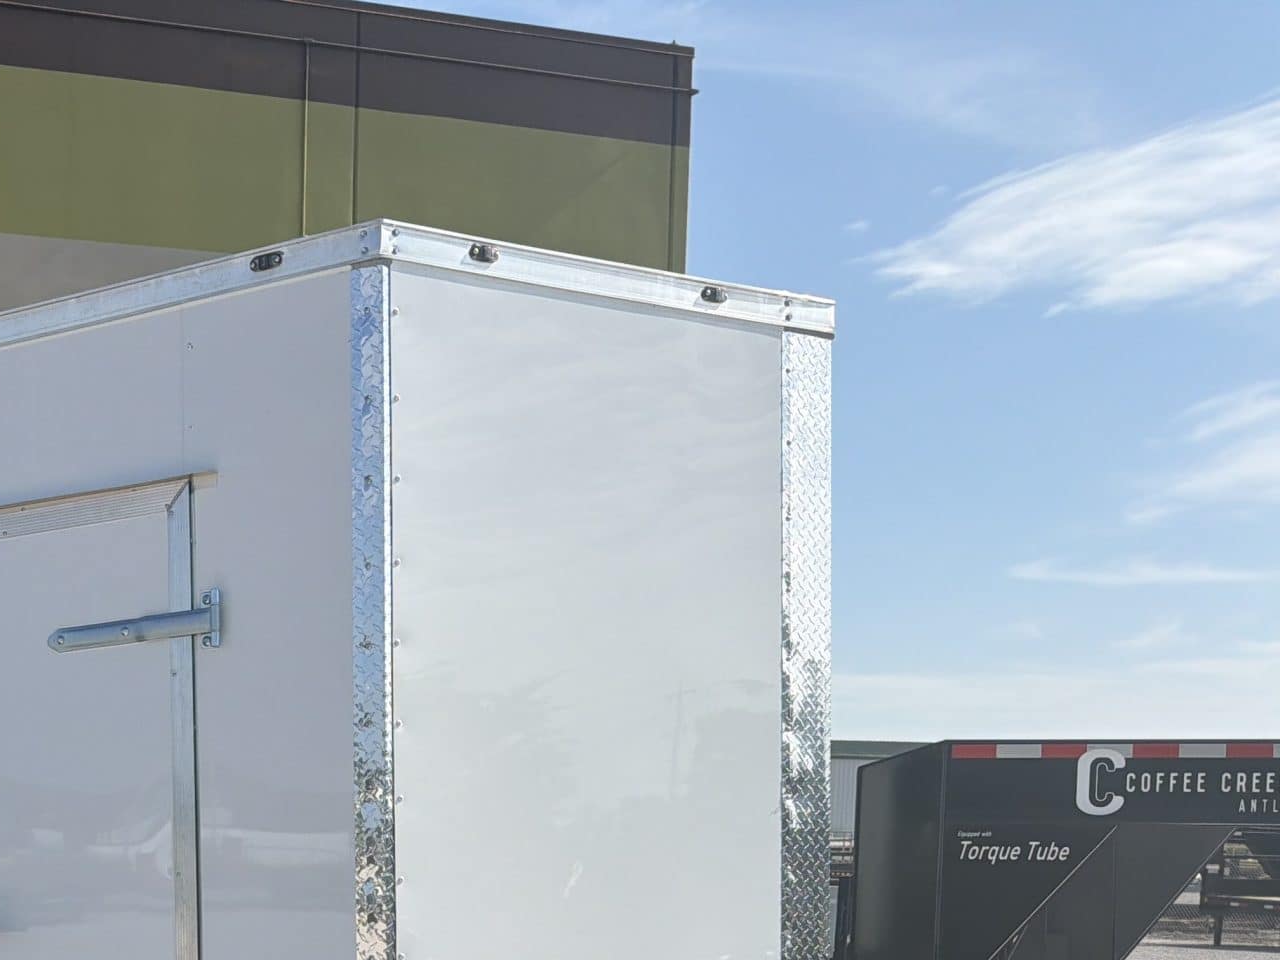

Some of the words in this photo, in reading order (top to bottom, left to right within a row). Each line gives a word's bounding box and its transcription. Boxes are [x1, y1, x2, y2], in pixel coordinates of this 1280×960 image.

[1126, 772, 1207, 793] COFFEE
[960, 841, 1021, 865] Torque
[1027, 841, 1070, 861] Tube
